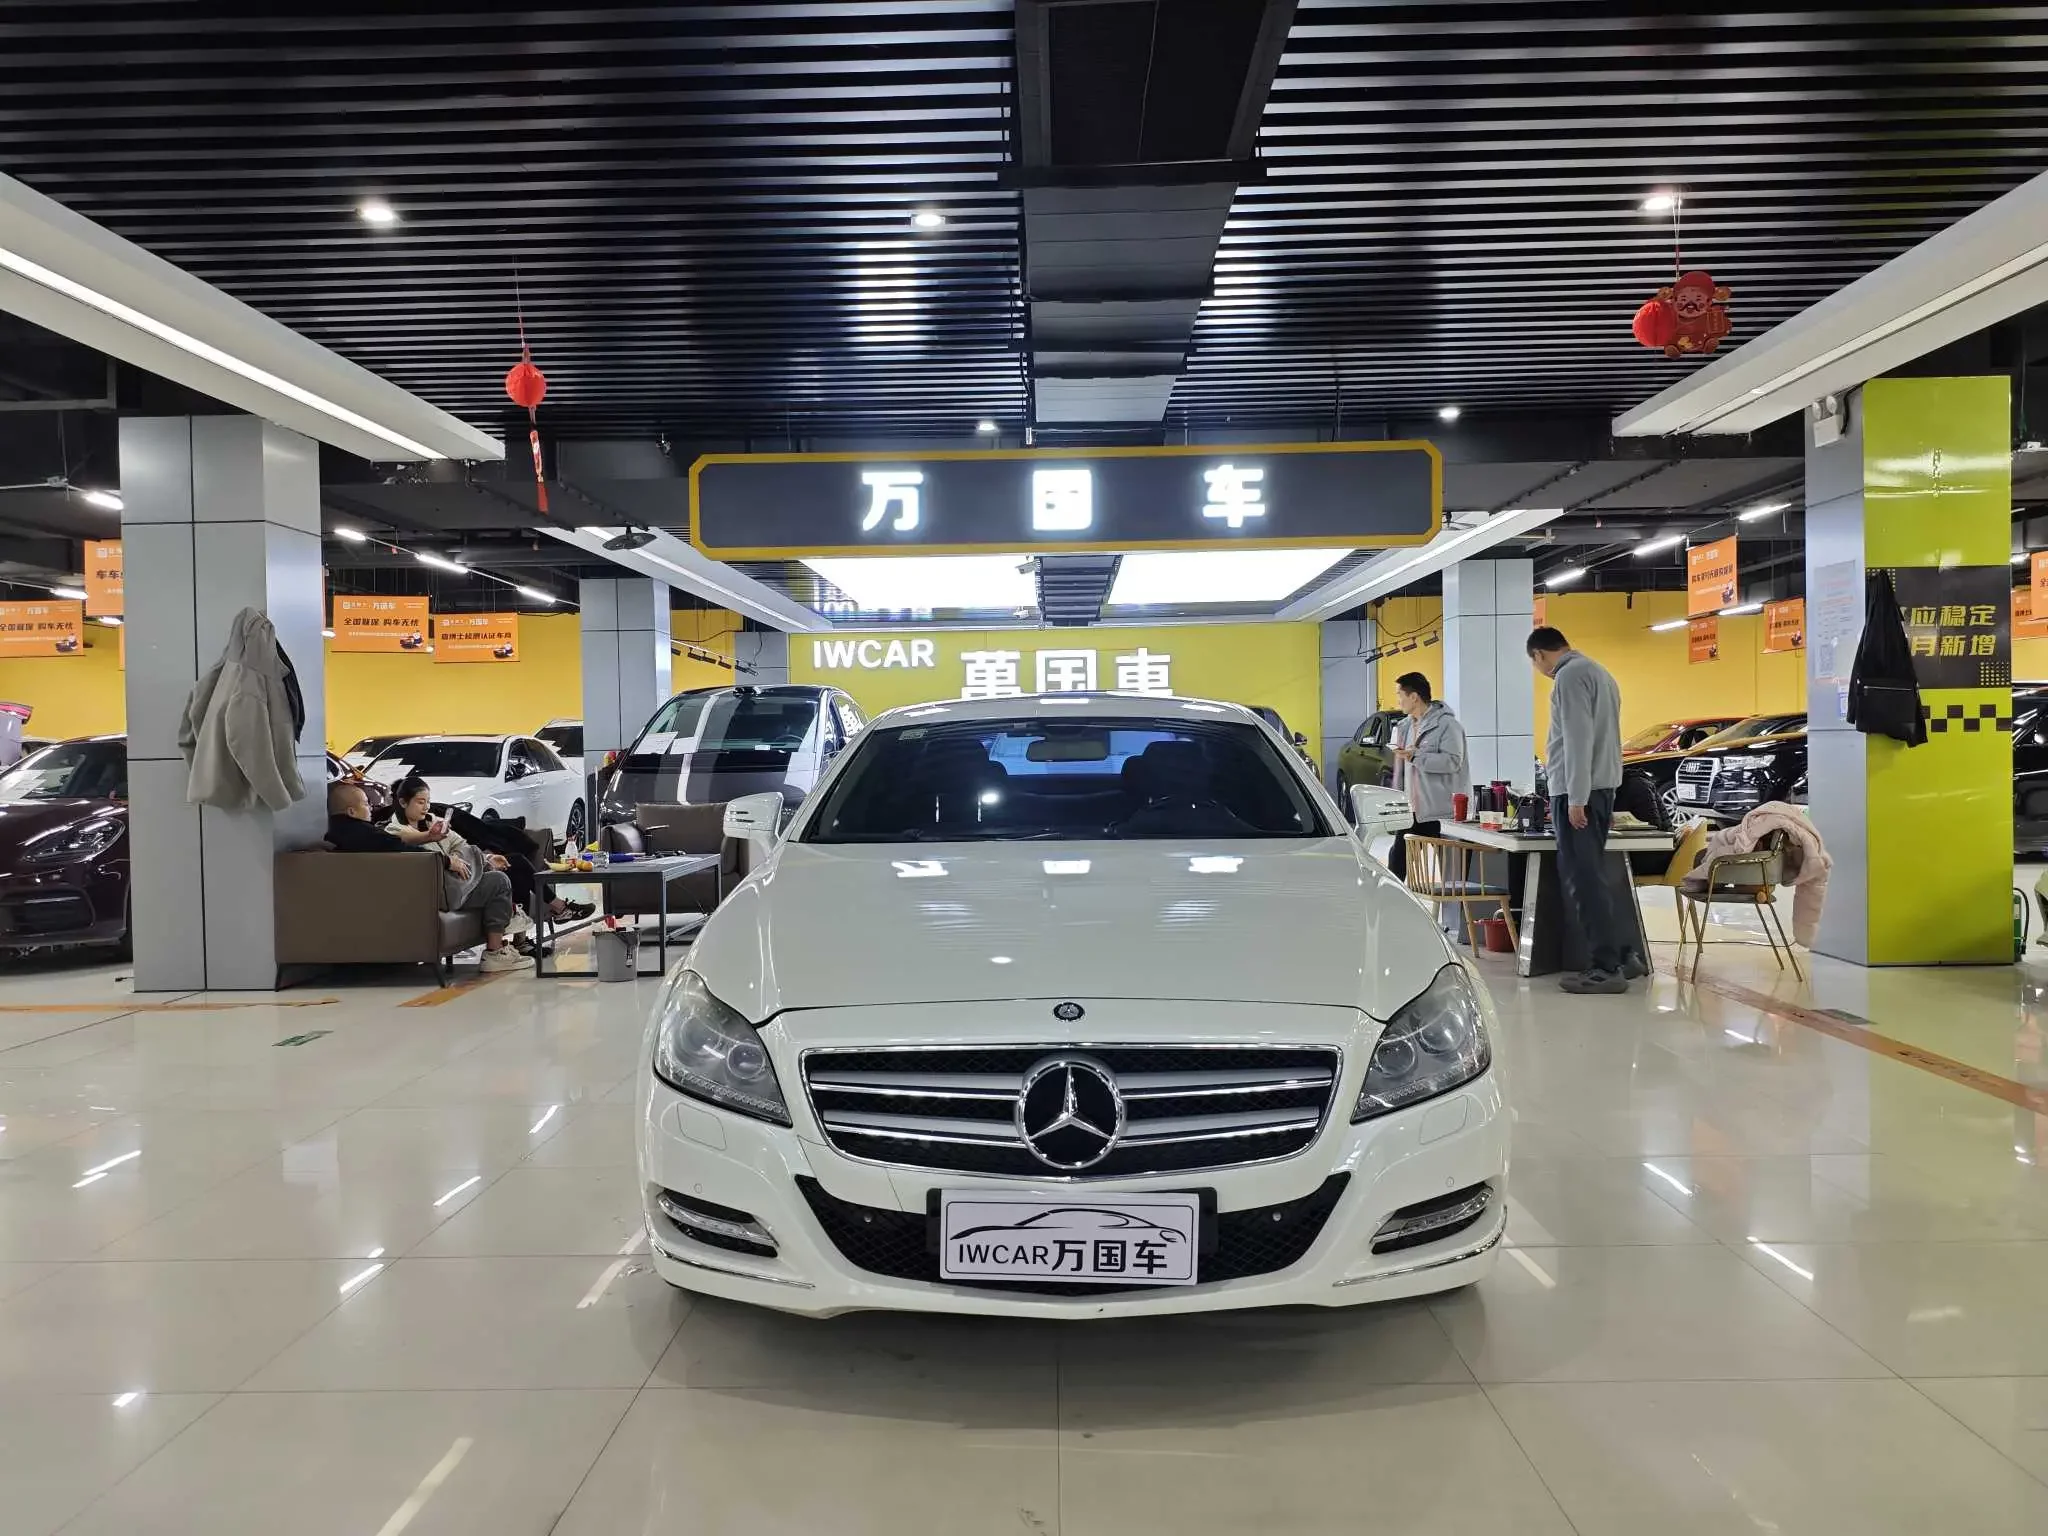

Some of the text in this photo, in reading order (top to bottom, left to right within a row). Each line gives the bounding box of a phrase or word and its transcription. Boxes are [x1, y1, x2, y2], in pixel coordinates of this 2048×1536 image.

[1900, 605, 1997, 628] 应稳定
[813, 638, 936, 669] IWCAR
